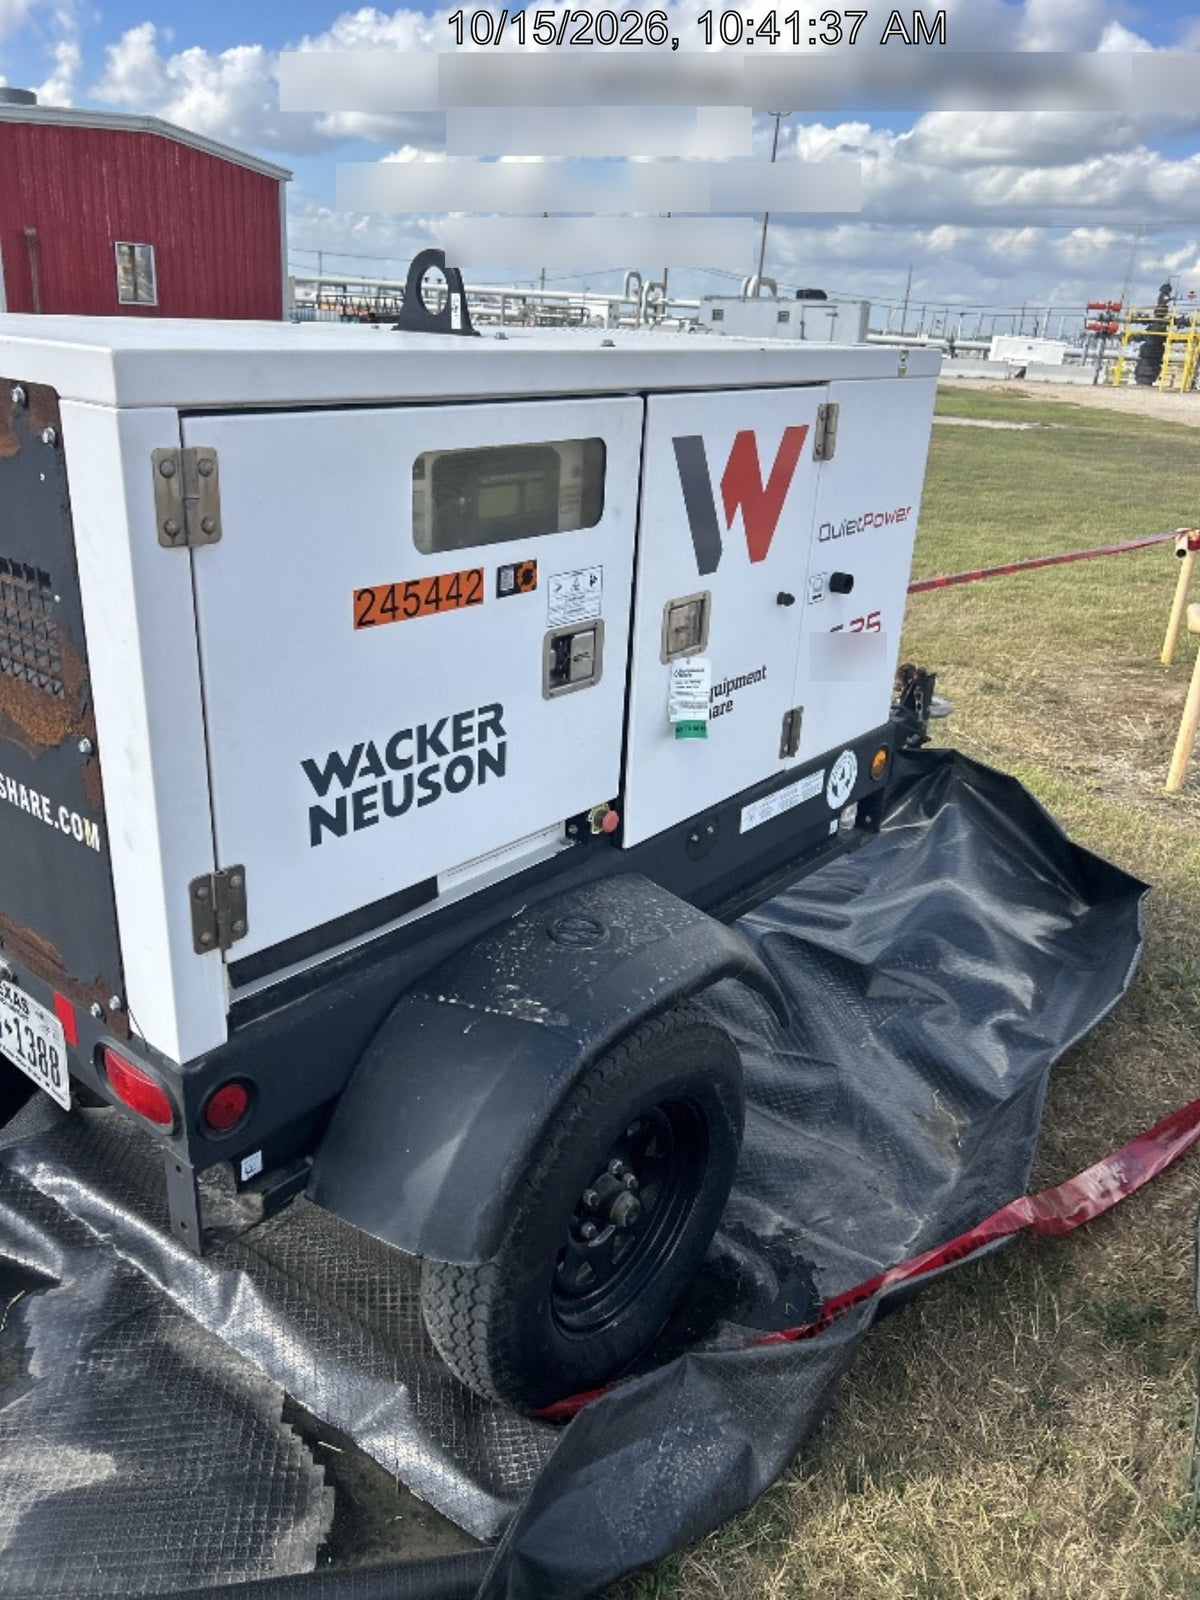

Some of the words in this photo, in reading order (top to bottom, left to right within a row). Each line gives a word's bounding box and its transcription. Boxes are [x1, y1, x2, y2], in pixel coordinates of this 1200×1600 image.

[818, 506, 911, 542] QuietPower
[356, 569, 483, 627] 245442
[300, 702, 507, 797] WACKER
[309, 741, 507, 848] NEUSON
